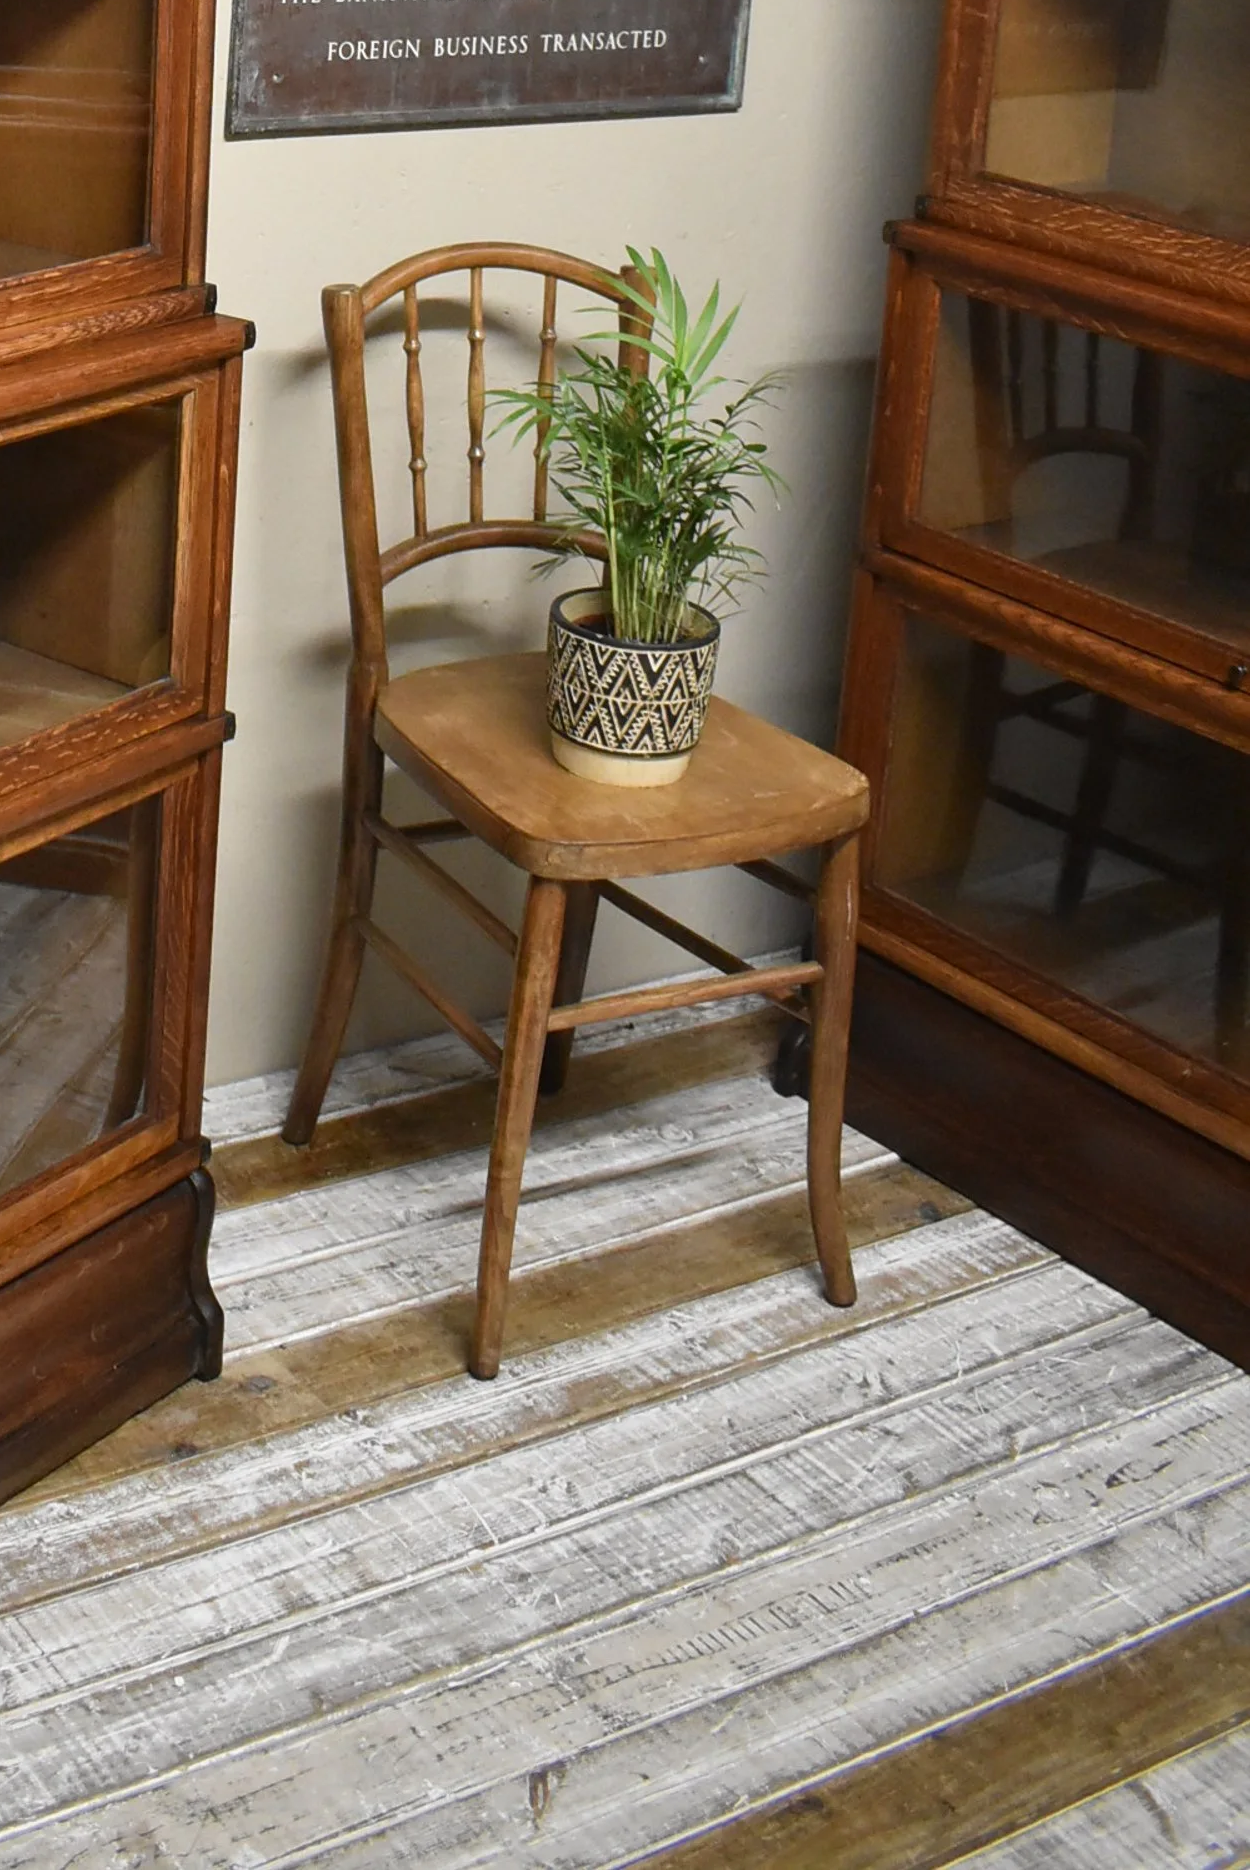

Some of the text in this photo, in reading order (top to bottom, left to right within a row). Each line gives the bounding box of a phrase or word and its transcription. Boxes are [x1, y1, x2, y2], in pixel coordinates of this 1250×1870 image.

[327, 28, 668, 62] FOREIGN BUSINESS TRANSACTED
